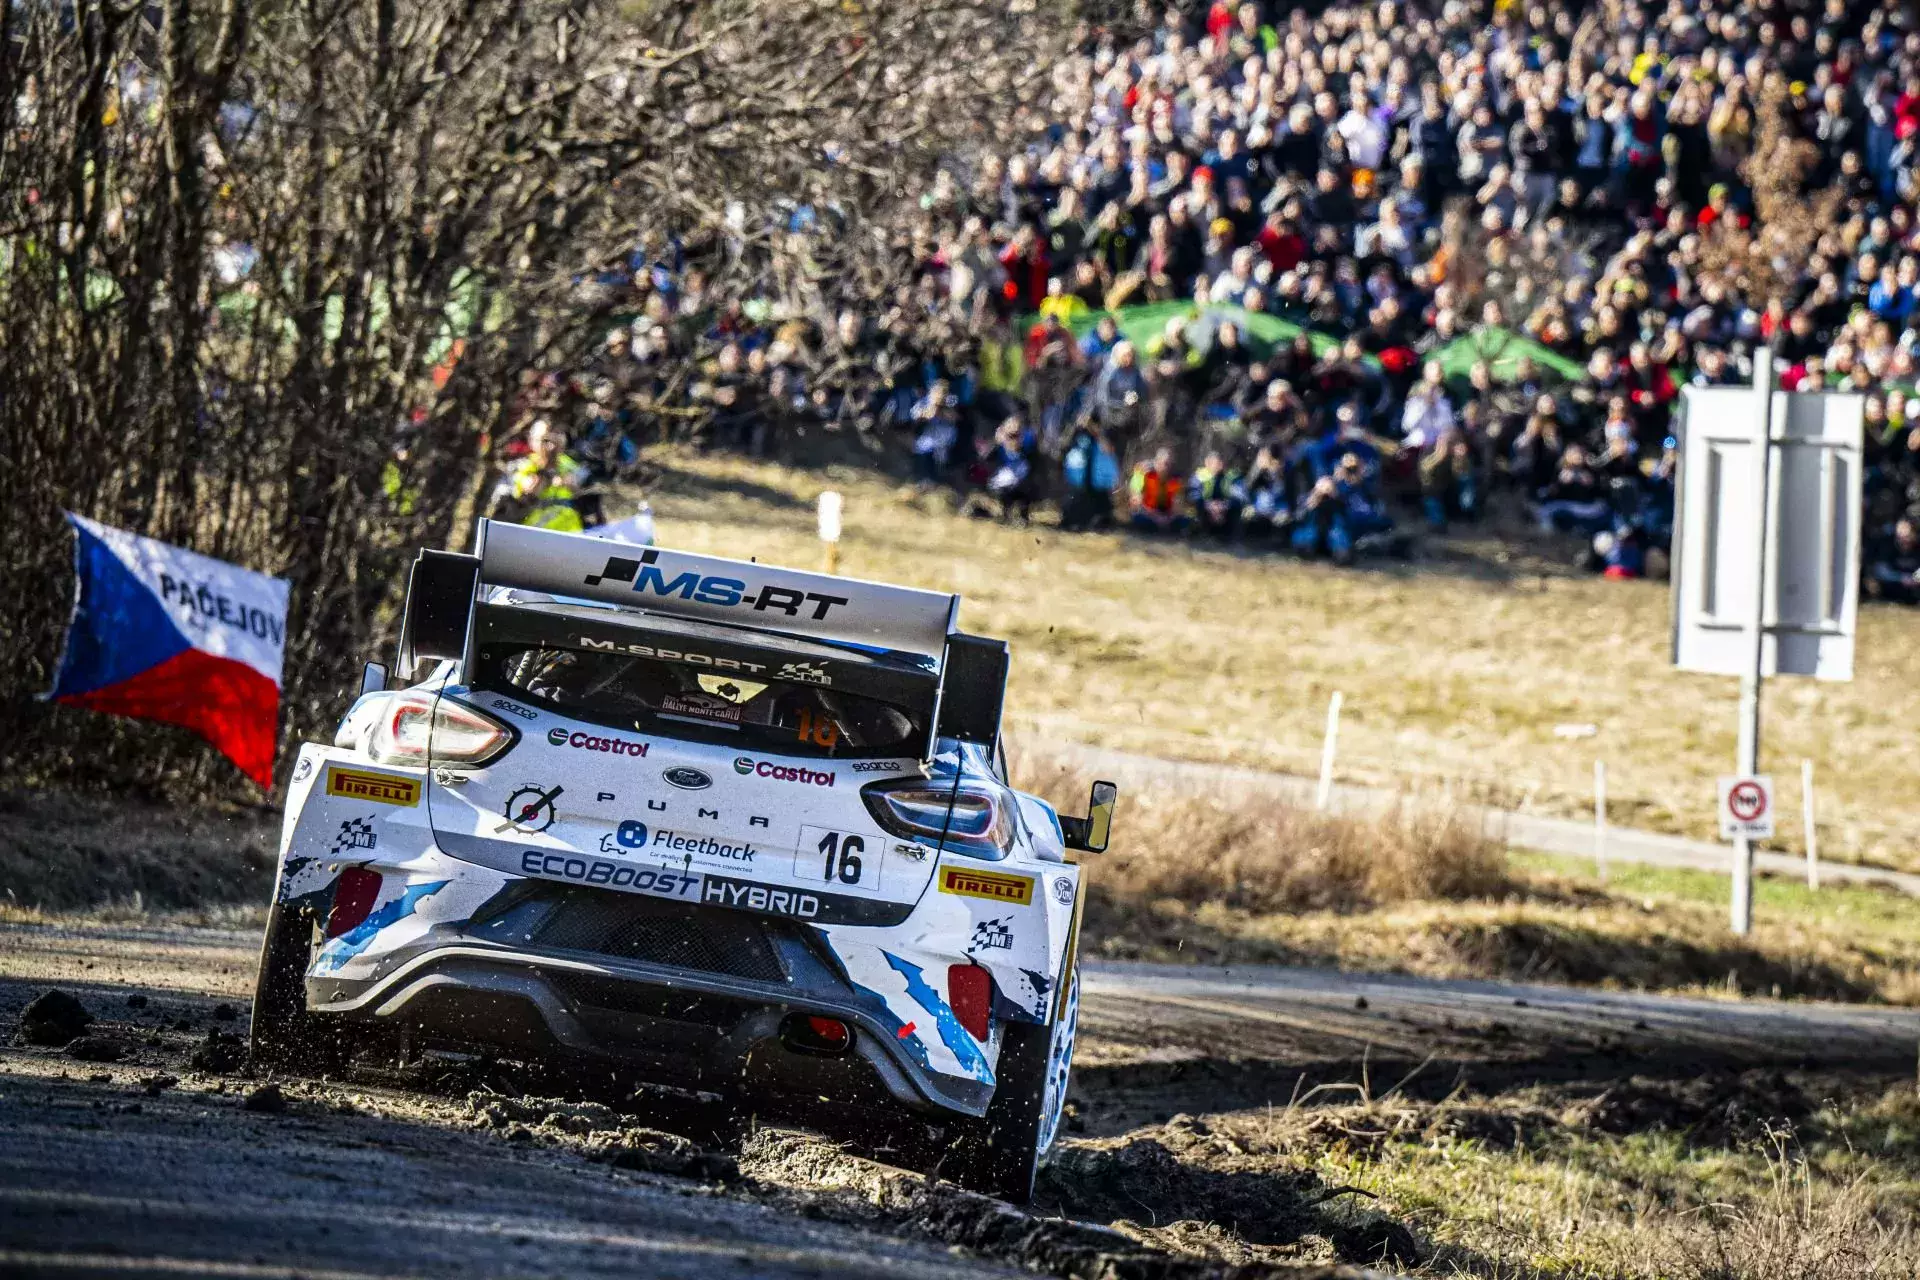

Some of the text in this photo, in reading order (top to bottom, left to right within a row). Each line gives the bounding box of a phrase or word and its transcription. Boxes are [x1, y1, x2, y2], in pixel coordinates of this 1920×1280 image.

[631, 565, 849, 620] MS-RT
[580, 637, 766, 673] M-SPORT
[491, 699, 538, 720] sparco
[662, 697, 687, 712] RALLYE
[795, 707, 839, 747] 16
[569, 732, 650, 757] Castrol
[756, 761, 836, 787] Castrol
[852, 761, 902, 772] sparco
[335, 773, 414, 802] PIRELLI
[597, 791, 769, 827] PUMA
[652, 829, 756, 862] Fleetback
[818, 831, 865, 885] 16
[705, 880, 818, 917] HYBRID
[945, 871, 1026, 900] PIRELLI
